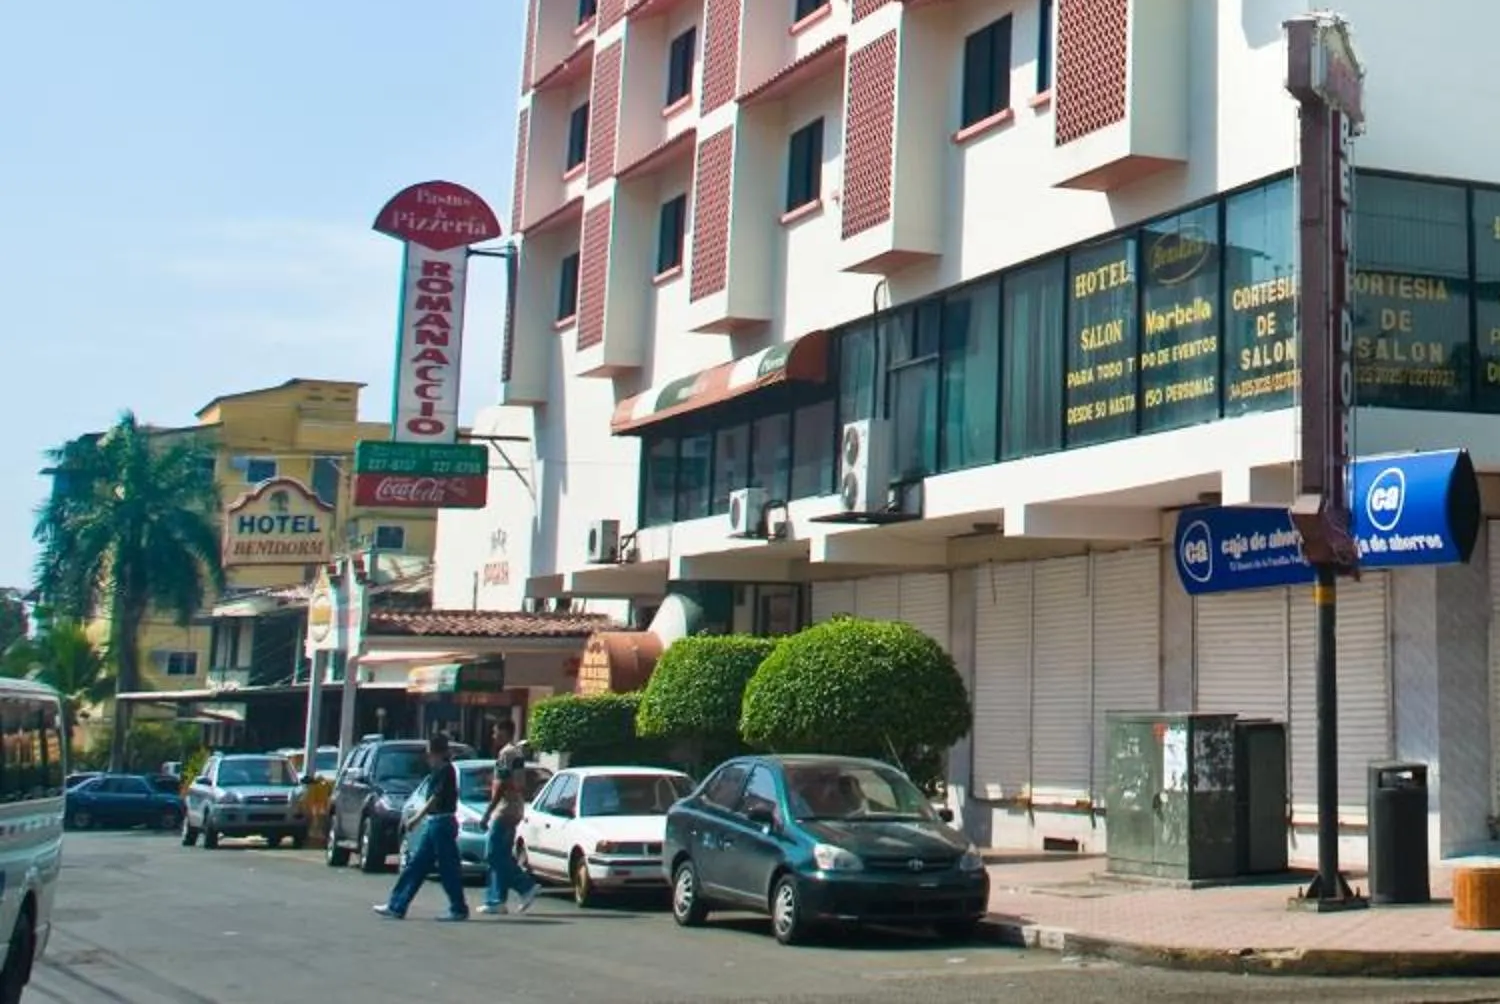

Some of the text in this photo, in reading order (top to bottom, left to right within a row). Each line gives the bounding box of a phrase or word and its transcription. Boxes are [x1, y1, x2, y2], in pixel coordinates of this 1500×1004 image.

[1075, 260, 1131, 298] HOTEL
[1256, 311, 1277, 337] DE
[1381, 308, 1413, 333] DE
[406, 259, 454, 436] ROMANACCIO
[1081, 320, 1125, 351] SALON
[1357, 336, 1443, 365] SALON
[1371, 486, 1398, 512] ca
[237, 514, 321, 534] HOTEL
[233, 539, 324, 556] BENIDORM
[1185, 539, 1209, 564] ca
[1221, 533, 1248, 559] caja
[1250, 531, 1267, 551] de
[1369, 533, 1387, 553] de
[1388, 533, 1443, 551] ahorros
